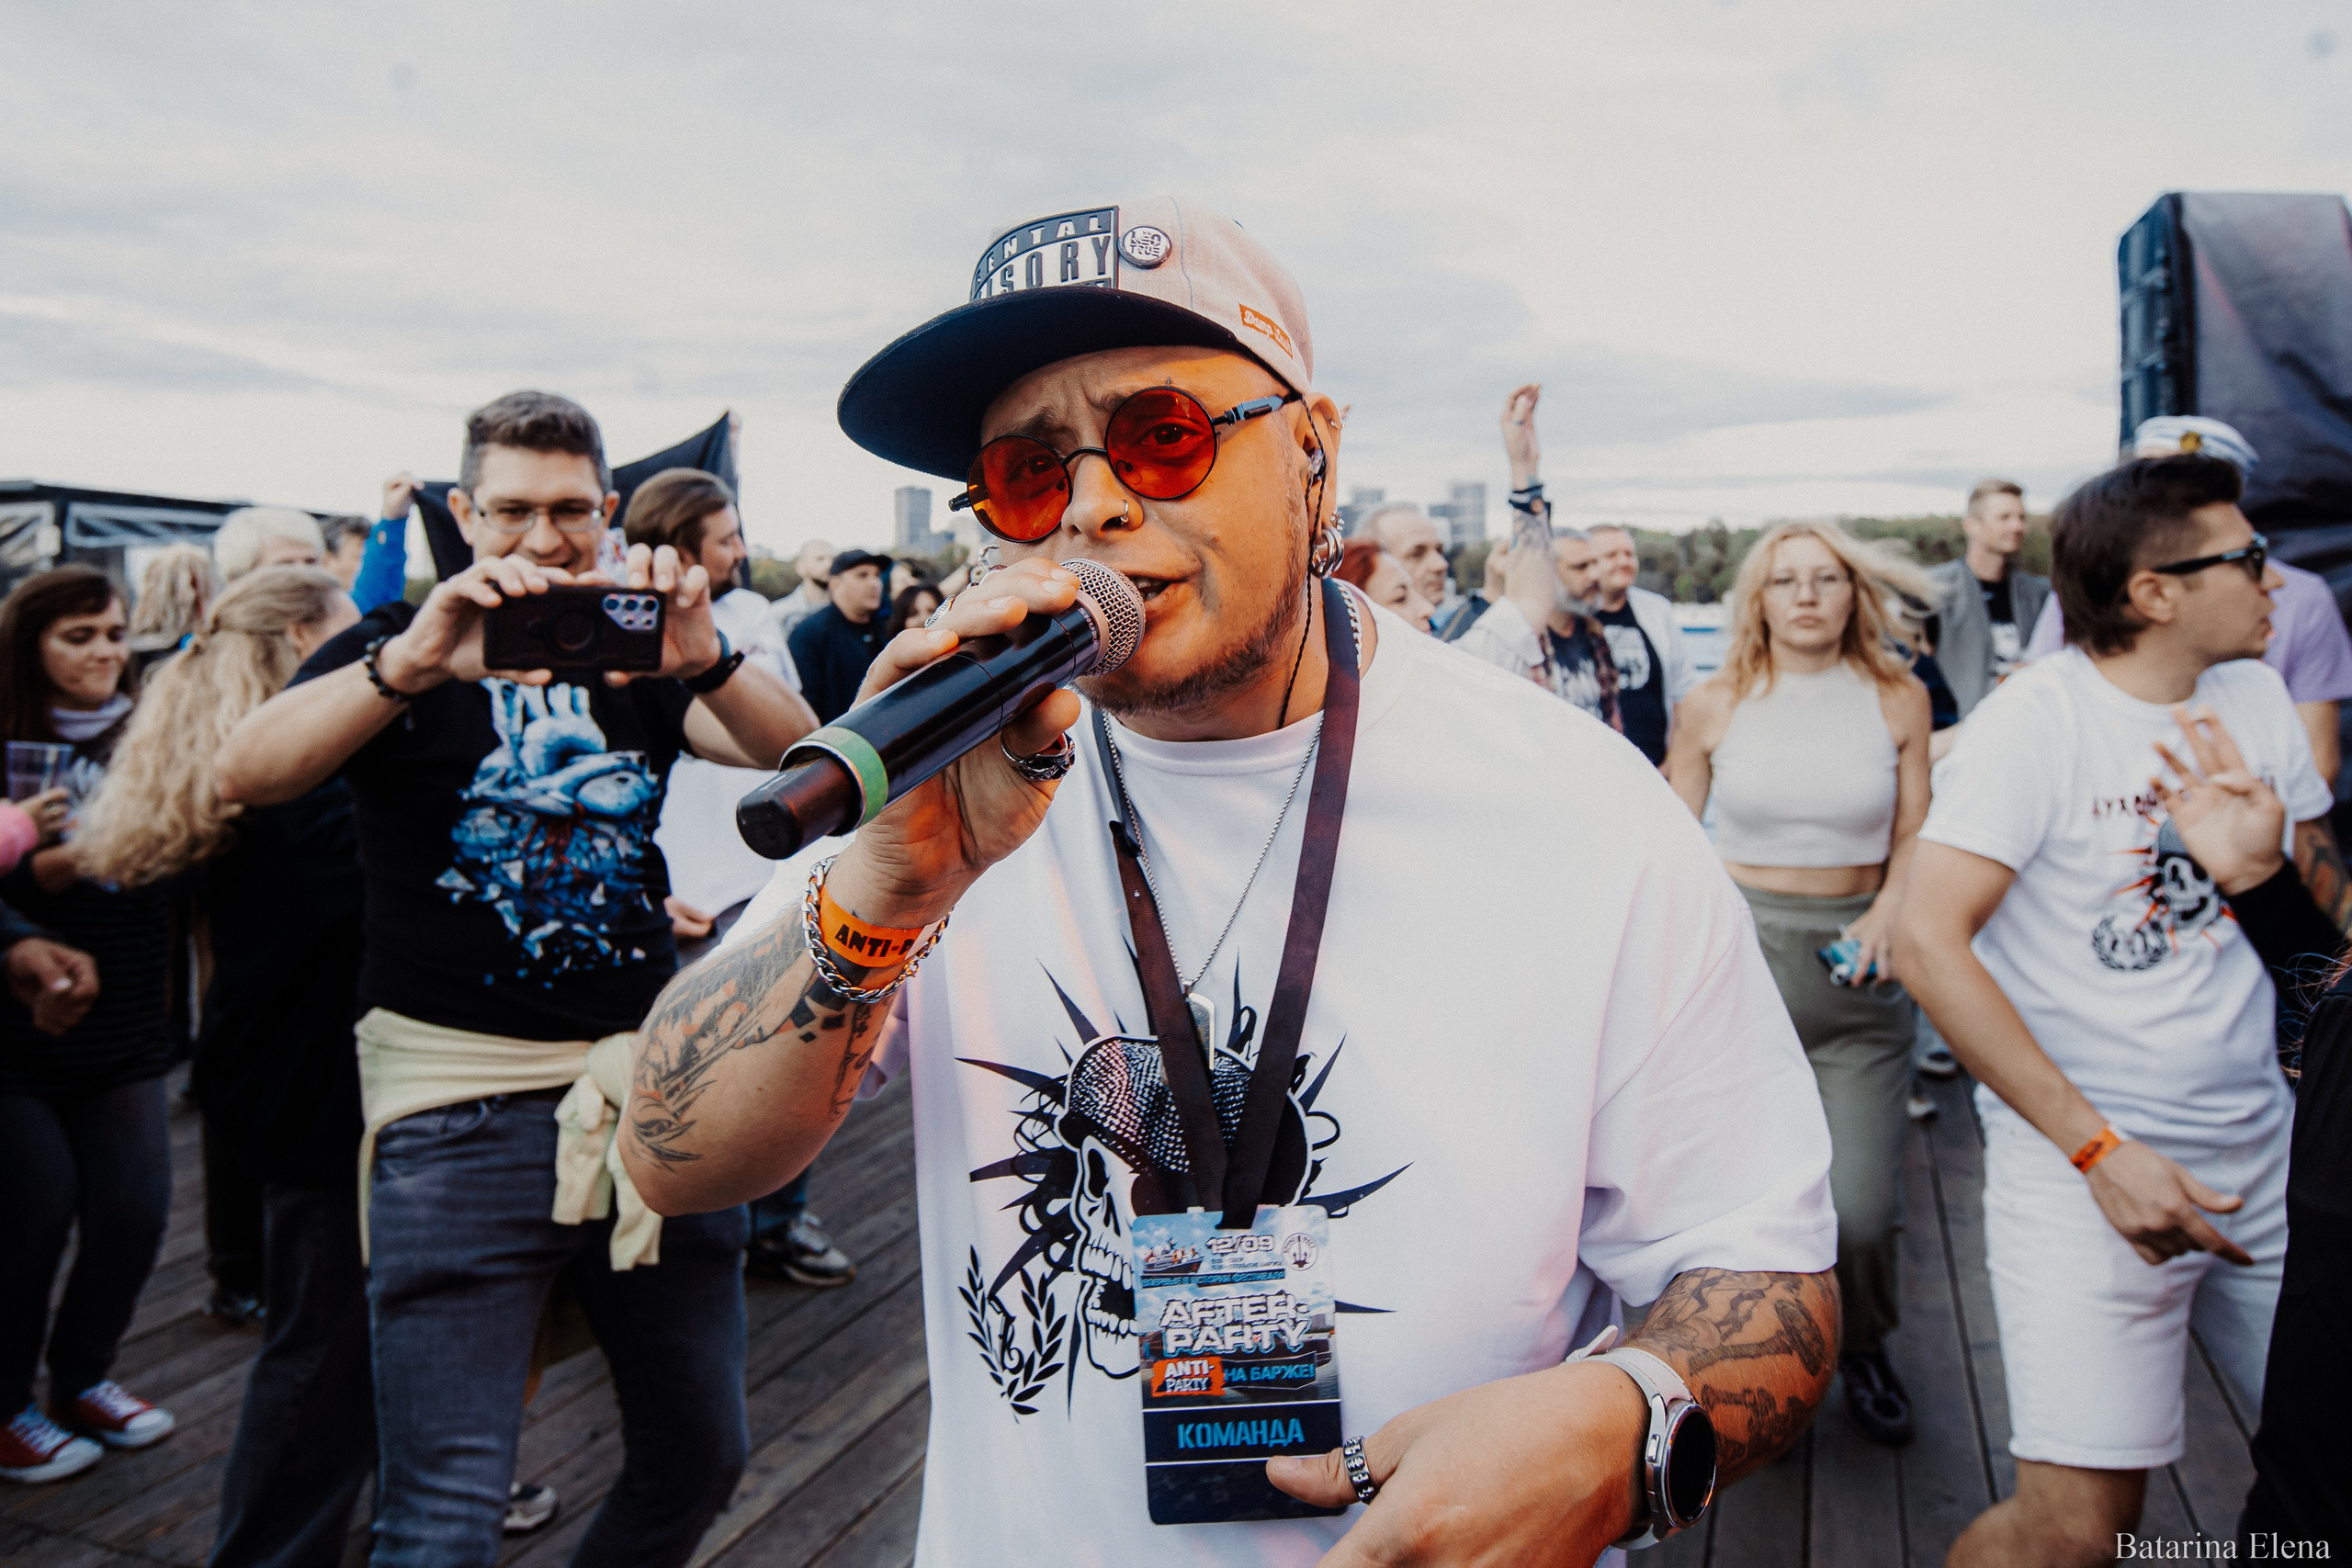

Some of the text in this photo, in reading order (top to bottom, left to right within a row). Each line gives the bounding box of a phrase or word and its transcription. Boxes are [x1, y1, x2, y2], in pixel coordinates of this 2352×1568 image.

[1206, 1235, 1274, 1255] 12/09
[1165, 1319, 1311, 1355] PARTY
[1164, 1359, 1216, 1378] ANTI-
[1225, 1363, 1315, 1382] НА БАРЖЕ!
[1165, 1377, 1209, 1393] PARTY
[1177, 1417, 1306, 1450] КОМАНДА
